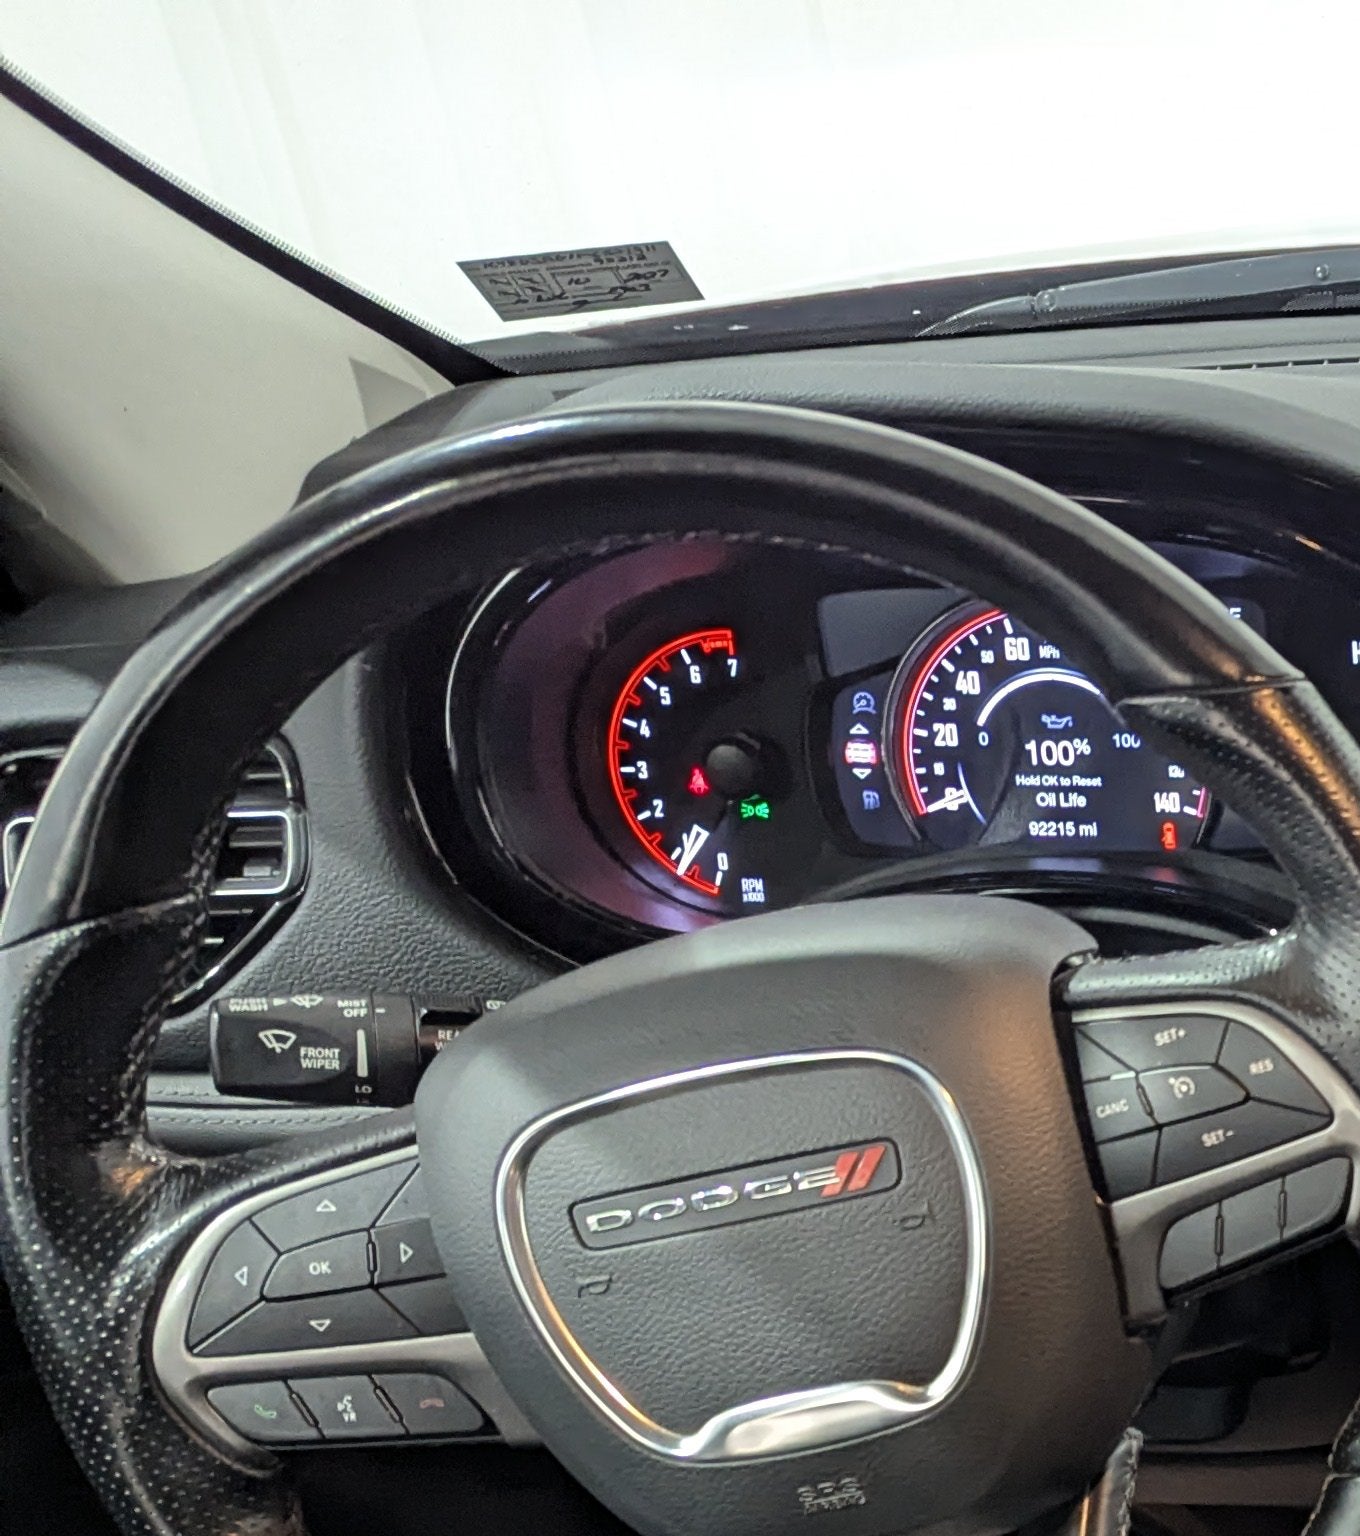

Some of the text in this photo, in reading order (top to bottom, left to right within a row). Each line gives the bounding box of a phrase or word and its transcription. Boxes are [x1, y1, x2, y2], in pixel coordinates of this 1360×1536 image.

[980, 650, 995, 664] 50
[1004, 637, 1031, 661] 60
[690, 665, 701, 684] 6
[727, 659, 737, 677] 7
[955, 670, 981, 695] 40
[660, 686, 671, 705] 5
[640, 719, 650, 738] 4
[933, 723, 959, 747] 20
[978, 732, 989, 746] 0
[1025, 738, 1091, 766] 100%
[637, 761, 648, 779] 3
[1015, 774, 1102, 787] Hold OK to Reset
[653, 799, 664, 817] 2
[1036, 792, 1087, 808] Oil Life
[1153, 792, 1180, 813] 140
[1029, 821, 1098, 837] 92215 mi
[717, 853, 728, 870] 0
[741, 878, 764, 892] RPM
[229, 1003, 268, 1012] WASH
[337, 1000, 368, 1008] MIST
[343, 1008, 368, 1017] OFF
[300, 1047, 341, 1060] FRONT
[300, 1058, 341, 1070] WIPER
[1249, 1059, 1275, 1075] RES
[354, 1085, 372, 1094] LO
[1096, 1099, 1130, 1118] CANC
[586, 1165, 841, 1233] DODGE
[309, 1261, 332, 1276] OK
